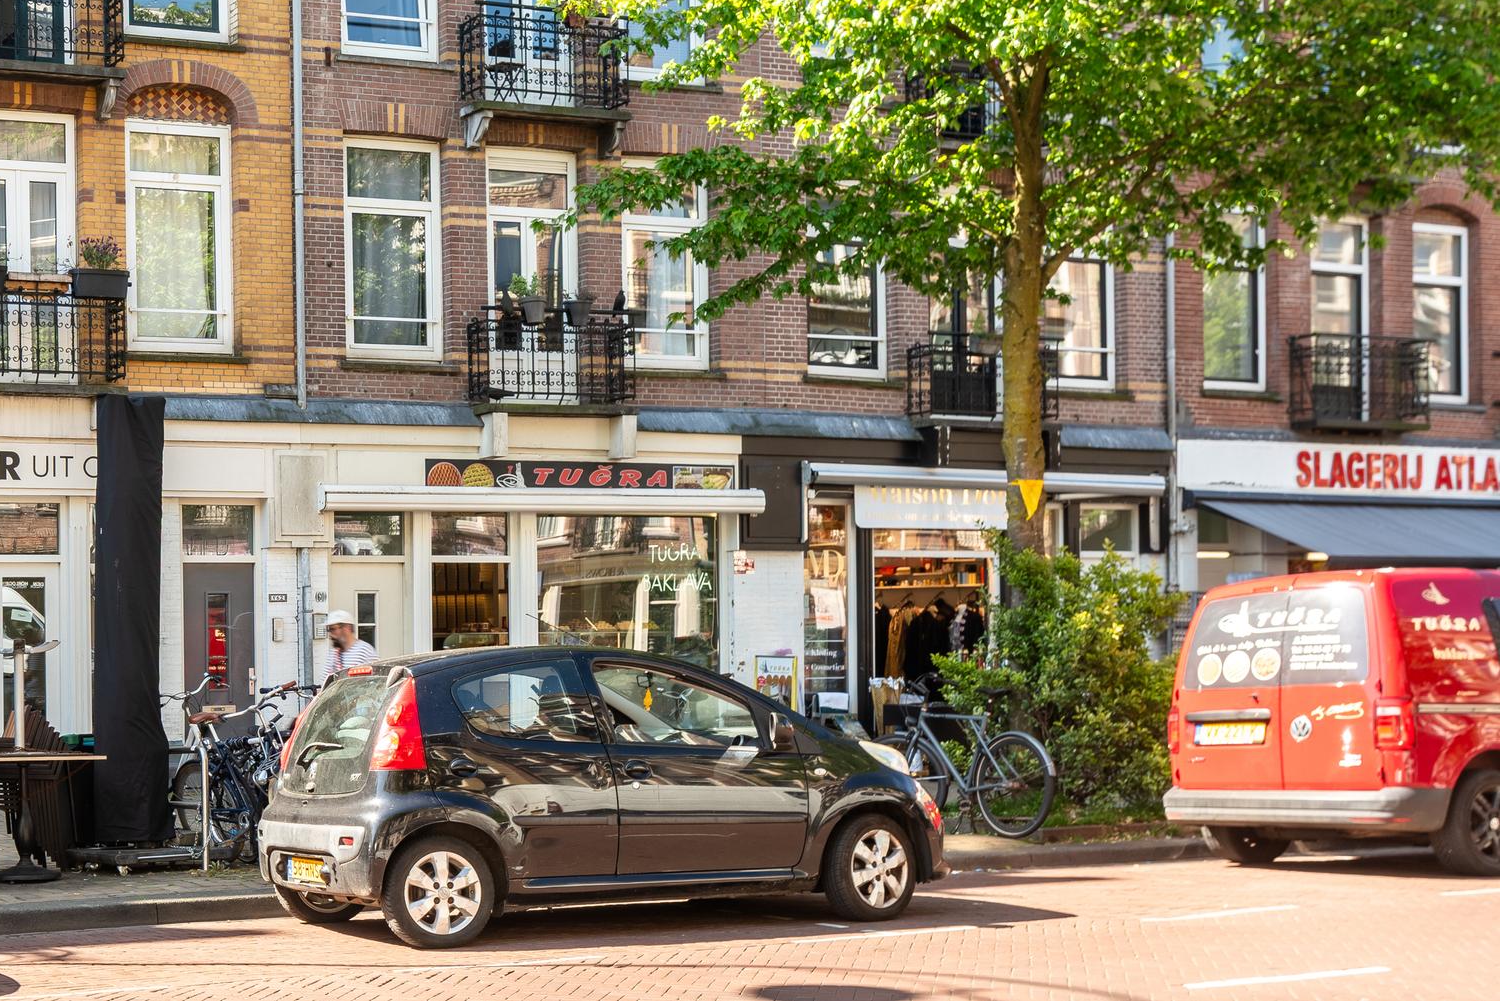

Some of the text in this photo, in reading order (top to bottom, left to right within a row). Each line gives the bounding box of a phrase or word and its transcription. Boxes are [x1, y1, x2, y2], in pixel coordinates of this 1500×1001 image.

[32, 455, 74, 478] UIT
[533, 465, 668, 488] TUĞRA
[1296, 450, 1424, 490] SLAGERIJ
[643, 572, 712, 592] BAKLAVA
